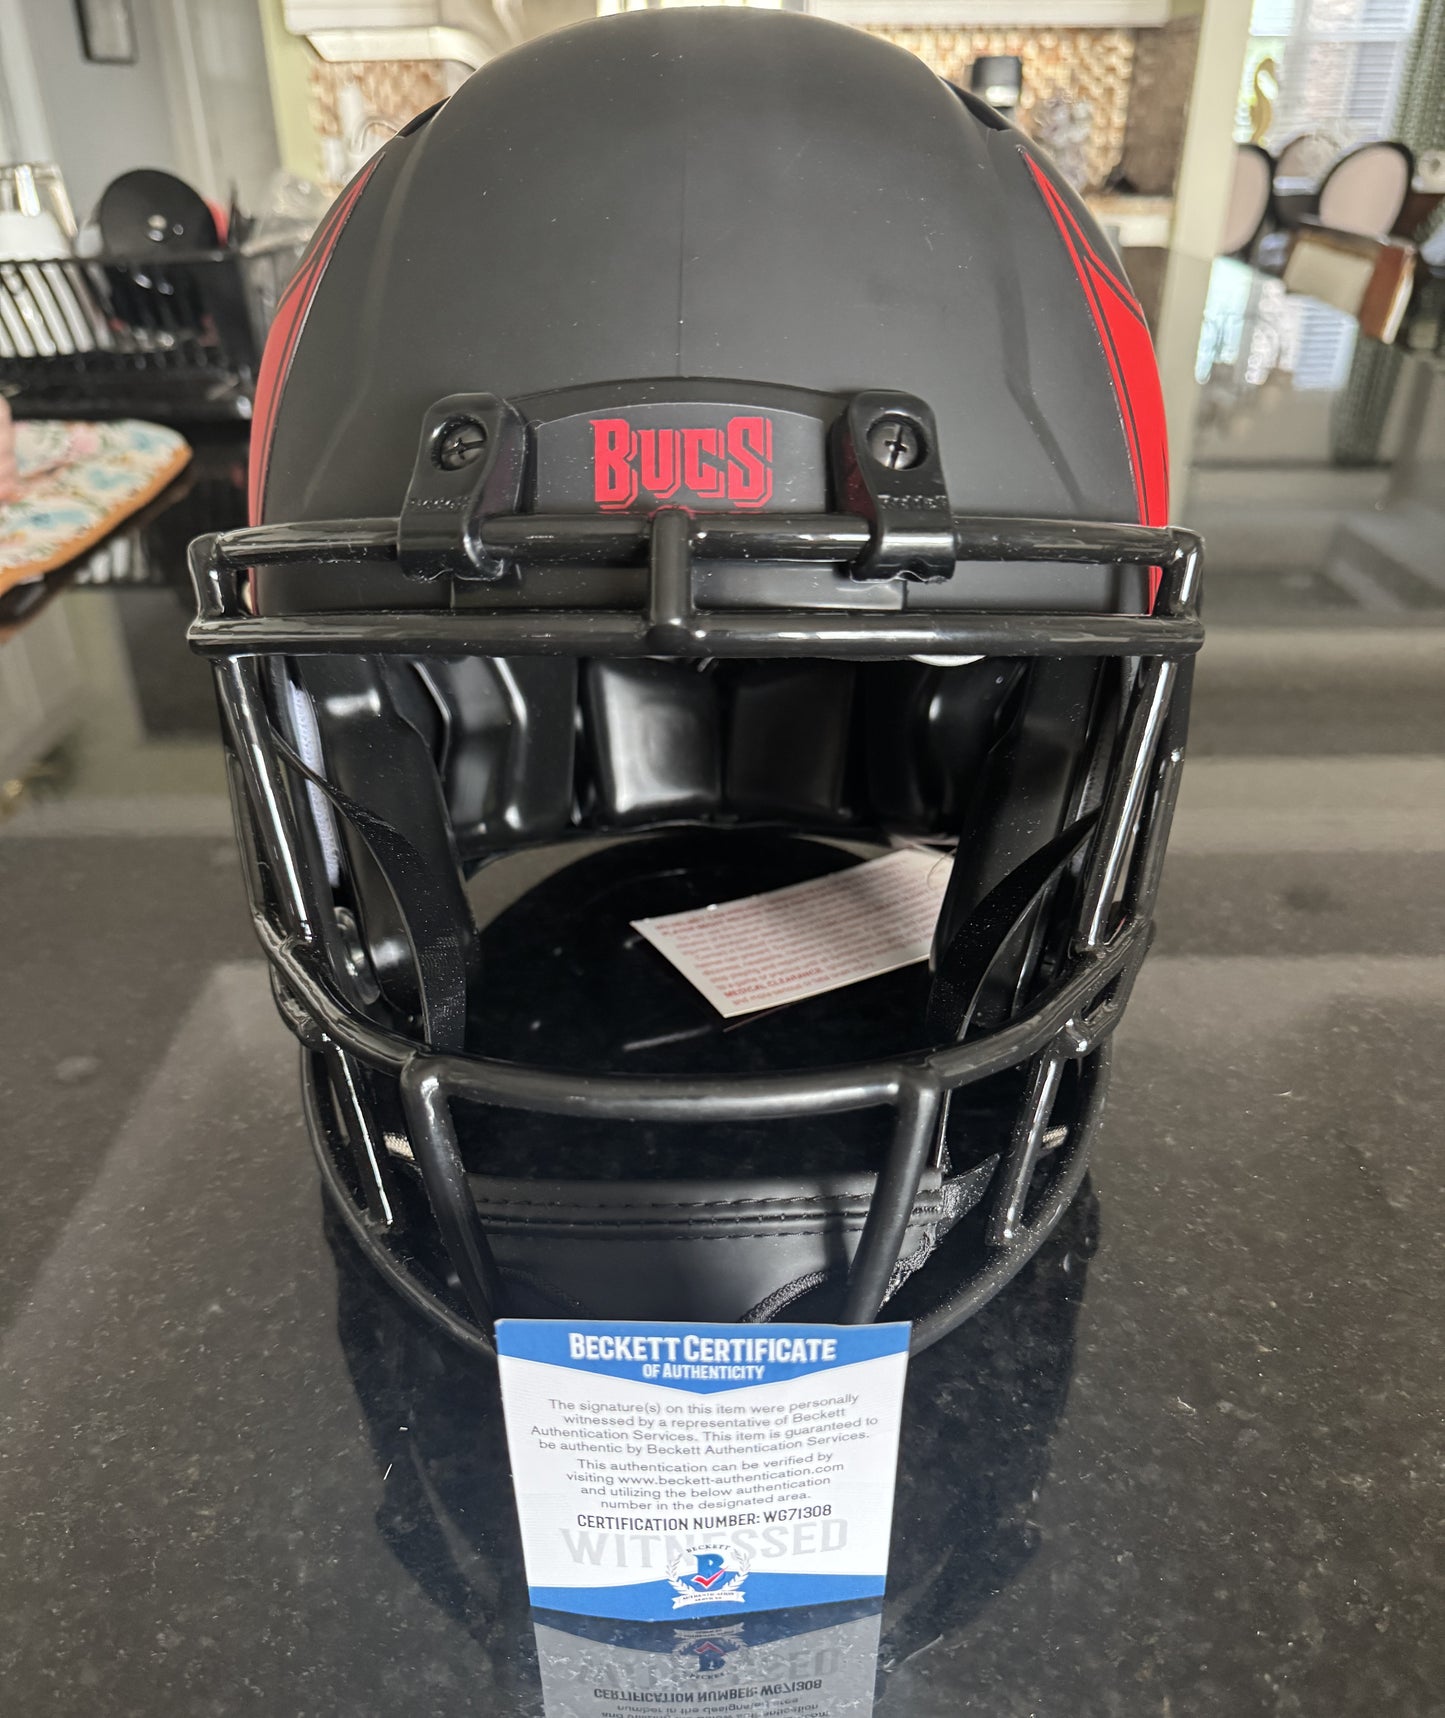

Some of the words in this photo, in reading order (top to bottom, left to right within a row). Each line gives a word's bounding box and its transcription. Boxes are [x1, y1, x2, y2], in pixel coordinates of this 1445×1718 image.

[589, 416, 773, 510] BUCS
[568, 1332, 680, 1361] BECKETT
[683, 1334, 838, 1364] CERTIFICATE
[642, 1363, 660, 1379] OF
[662, 1363, 765, 1380] AUTHENTICITY
[549, 1398, 576, 1411] The
[580, 1401, 661, 1415] signature(s)
[666, 1405, 683, 1414] on
[687, 1403, 712, 1415] this
[716, 1404, 746, 1415] item
[750, 1403, 785, 1414] were
[789, 1393, 860, 1412] personally
[531, 1425, 629, 1441] Authentication
[633, 1430, 698, 1442] Services.
[702, 1431, 732, 1442] This
[736, 1430, 766, 1441] item
[769, 1429, 781, 1439] is
[785, 1417, 862, 1439] guaranteed
[866, 1415, 879, 1426] to
[563, 1414, 635, 1427] witnessed
[638, 1415, 656, 1429] by
[659, 1419, 668, 1427] a
[671, 1415, 771, 1430] representative
[775, 1415, 789, 1426] of
[792, 1407, 846, 1423] Beckett
[539, 1438, 557, 1450] be
[560, 1440, 623, 1454] authentic
[627, 1443, 642, 1456] by
[647, 1443, 701, 1455] Beckett
[705, 1439, 802, 1455] Authentication
[807, 1430, 870, 1447] Services.
[566, 1471, 614, 1486] visiting
[618, 1462, 844, 1486] www.beckett-authentication.com
[577, 1458, 607, 1471] This
[610, 1460, 708, 1473] authentication
[712, 1463, 737, 1473] can
[741, 1460, 759, 1471] be
[763, 1453, 814, 1468] verified
[817, 1451, 834, 1464] by
[581, 1485, 606, 1496] and
[610, 1486, 661, 1500] utilizing
[665, 1487, 687, 1498] the
[691, 1487, 733, 1498] below
[736, 1476, 831, 1496] authentication
[601, 1500, 652, 1511] number
[657, 1500, 668, 1510] in
[673, 1500, 693, 1510] the
[698, 1496, 774, 1510] designated
[777, 1492, 812, 1503] area.
[577, 1514, 688, 1532] CERTIFICATION
[693, 1512, 760, 1530] NUMBER:
[763, 1504, 832, 1523] WG71308
[686, 1543, 731, 1553] BECKETT
